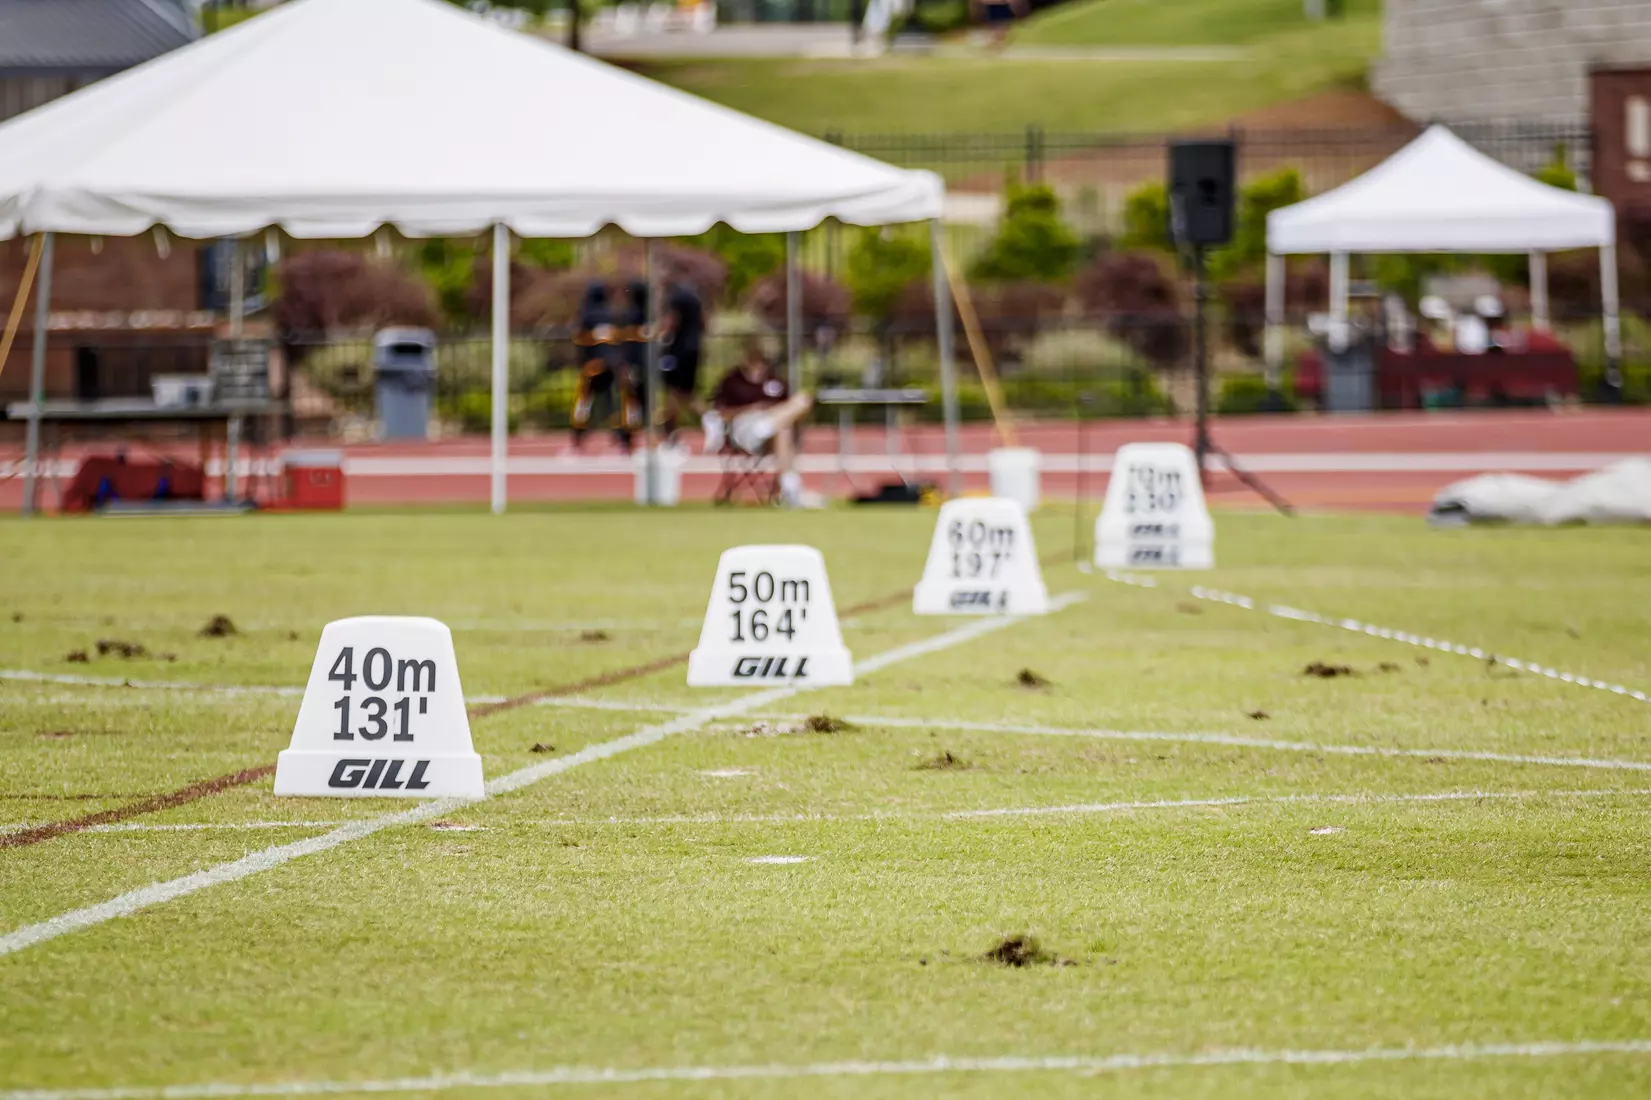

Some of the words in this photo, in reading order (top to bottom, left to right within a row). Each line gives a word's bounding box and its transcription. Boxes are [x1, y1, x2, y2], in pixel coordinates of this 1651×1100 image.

[948, 519, 1014, 546] 60m
[729, 571, 810, 604] 50m
[731, 608, 807, 642] 164'
[328, 646, 436, 692] 40m
[733, 656, 808, 678] GILL
[333, 695, 428, 742] 131'
[327, 758, 431, 790] GILL
